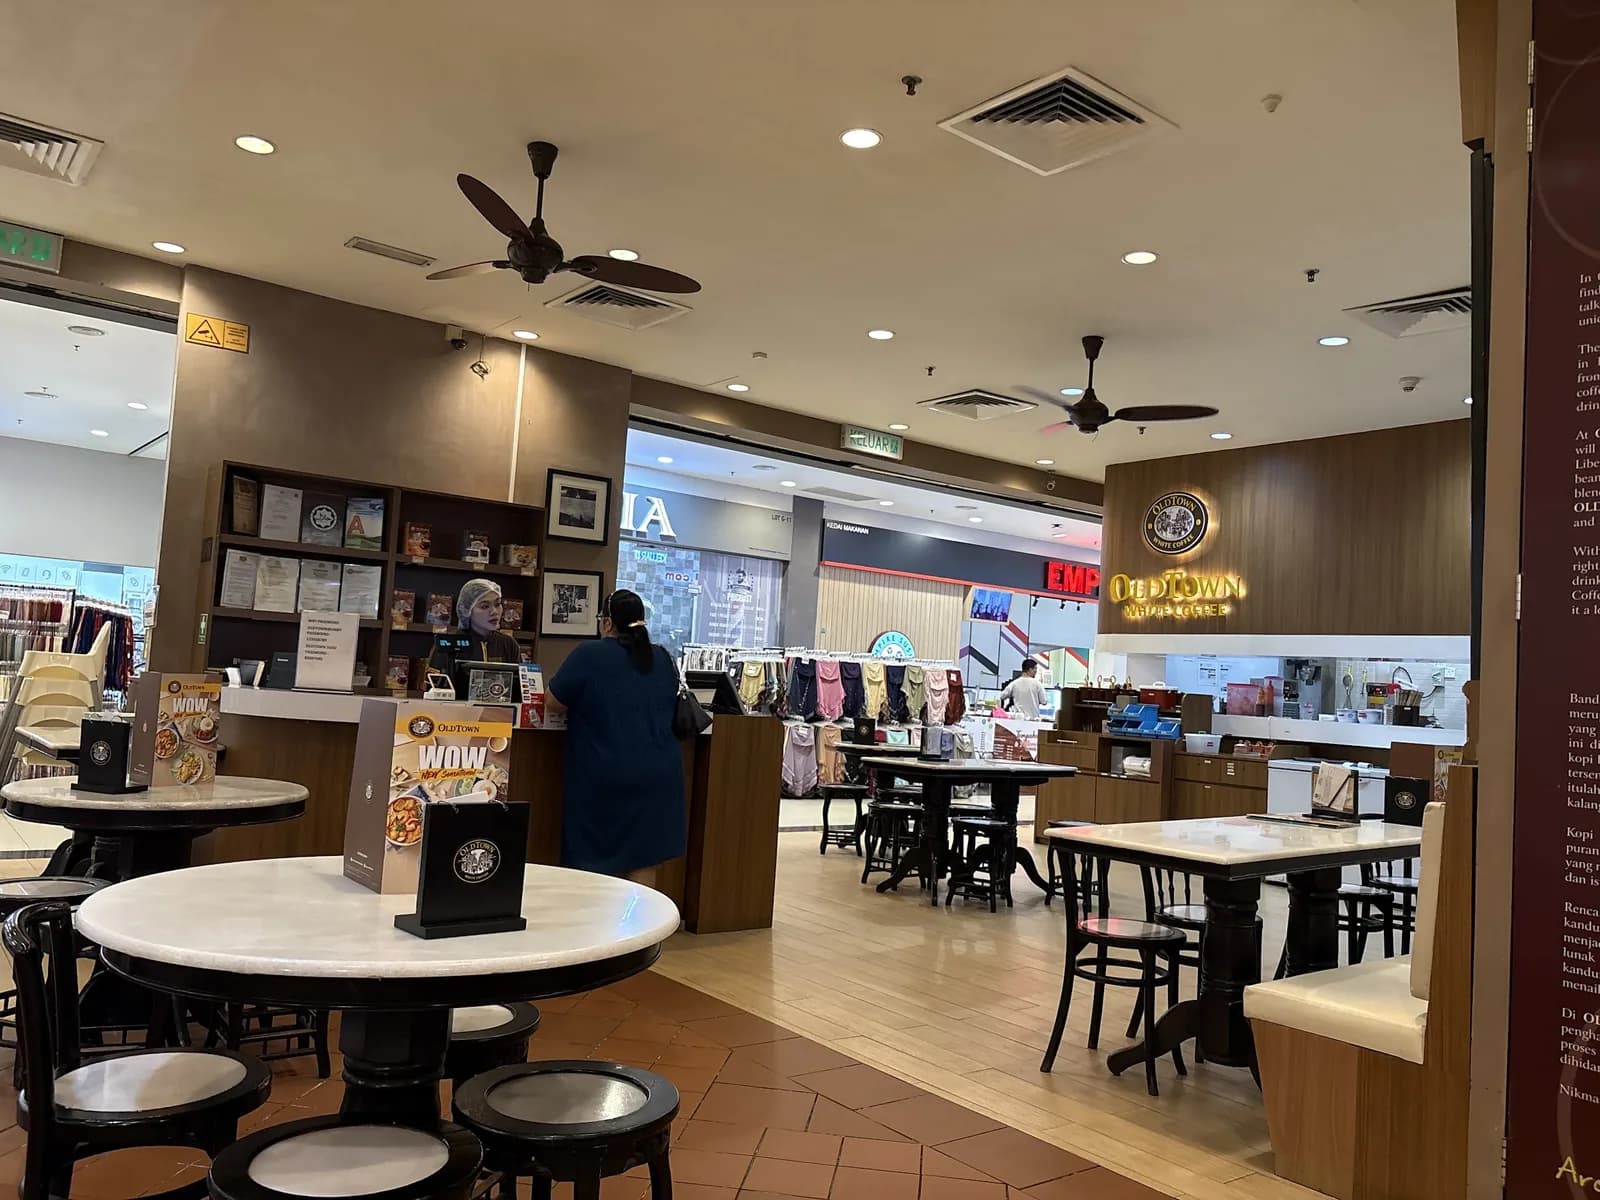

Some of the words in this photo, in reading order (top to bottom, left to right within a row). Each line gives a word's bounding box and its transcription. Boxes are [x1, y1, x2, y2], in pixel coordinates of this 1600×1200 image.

[1580, 274, 1592, 284] In
[1578, 359, 1589, 369] in
[848, 428, 889, 452] KELUAR
[1575, 429, 1588, 441] At
[1575, 443, 1596, 455] will
[1573, 516, 1595, 527] and
[1572, 560, 1599, 574] right
[172, 697, 209, 713] WOW
[1568, 725, 1597, 737] yang
[1568, 738, 1584, 748] ini
[418, 745, 488, 770] WOW
[1568, 752, 1593, 767] kopi
[1567, 827, 1593, 842] Kopi
[1564, 860, 1593, 873] yang
[1564, 872, 1586, 884] dan
[1564, 901, 1599, 917] Renca
[1563, 946, 1596, 963] lunak
[1561, 1007, 1576, 1020] Di
[1560, 1040, 1597, 1056] proses
